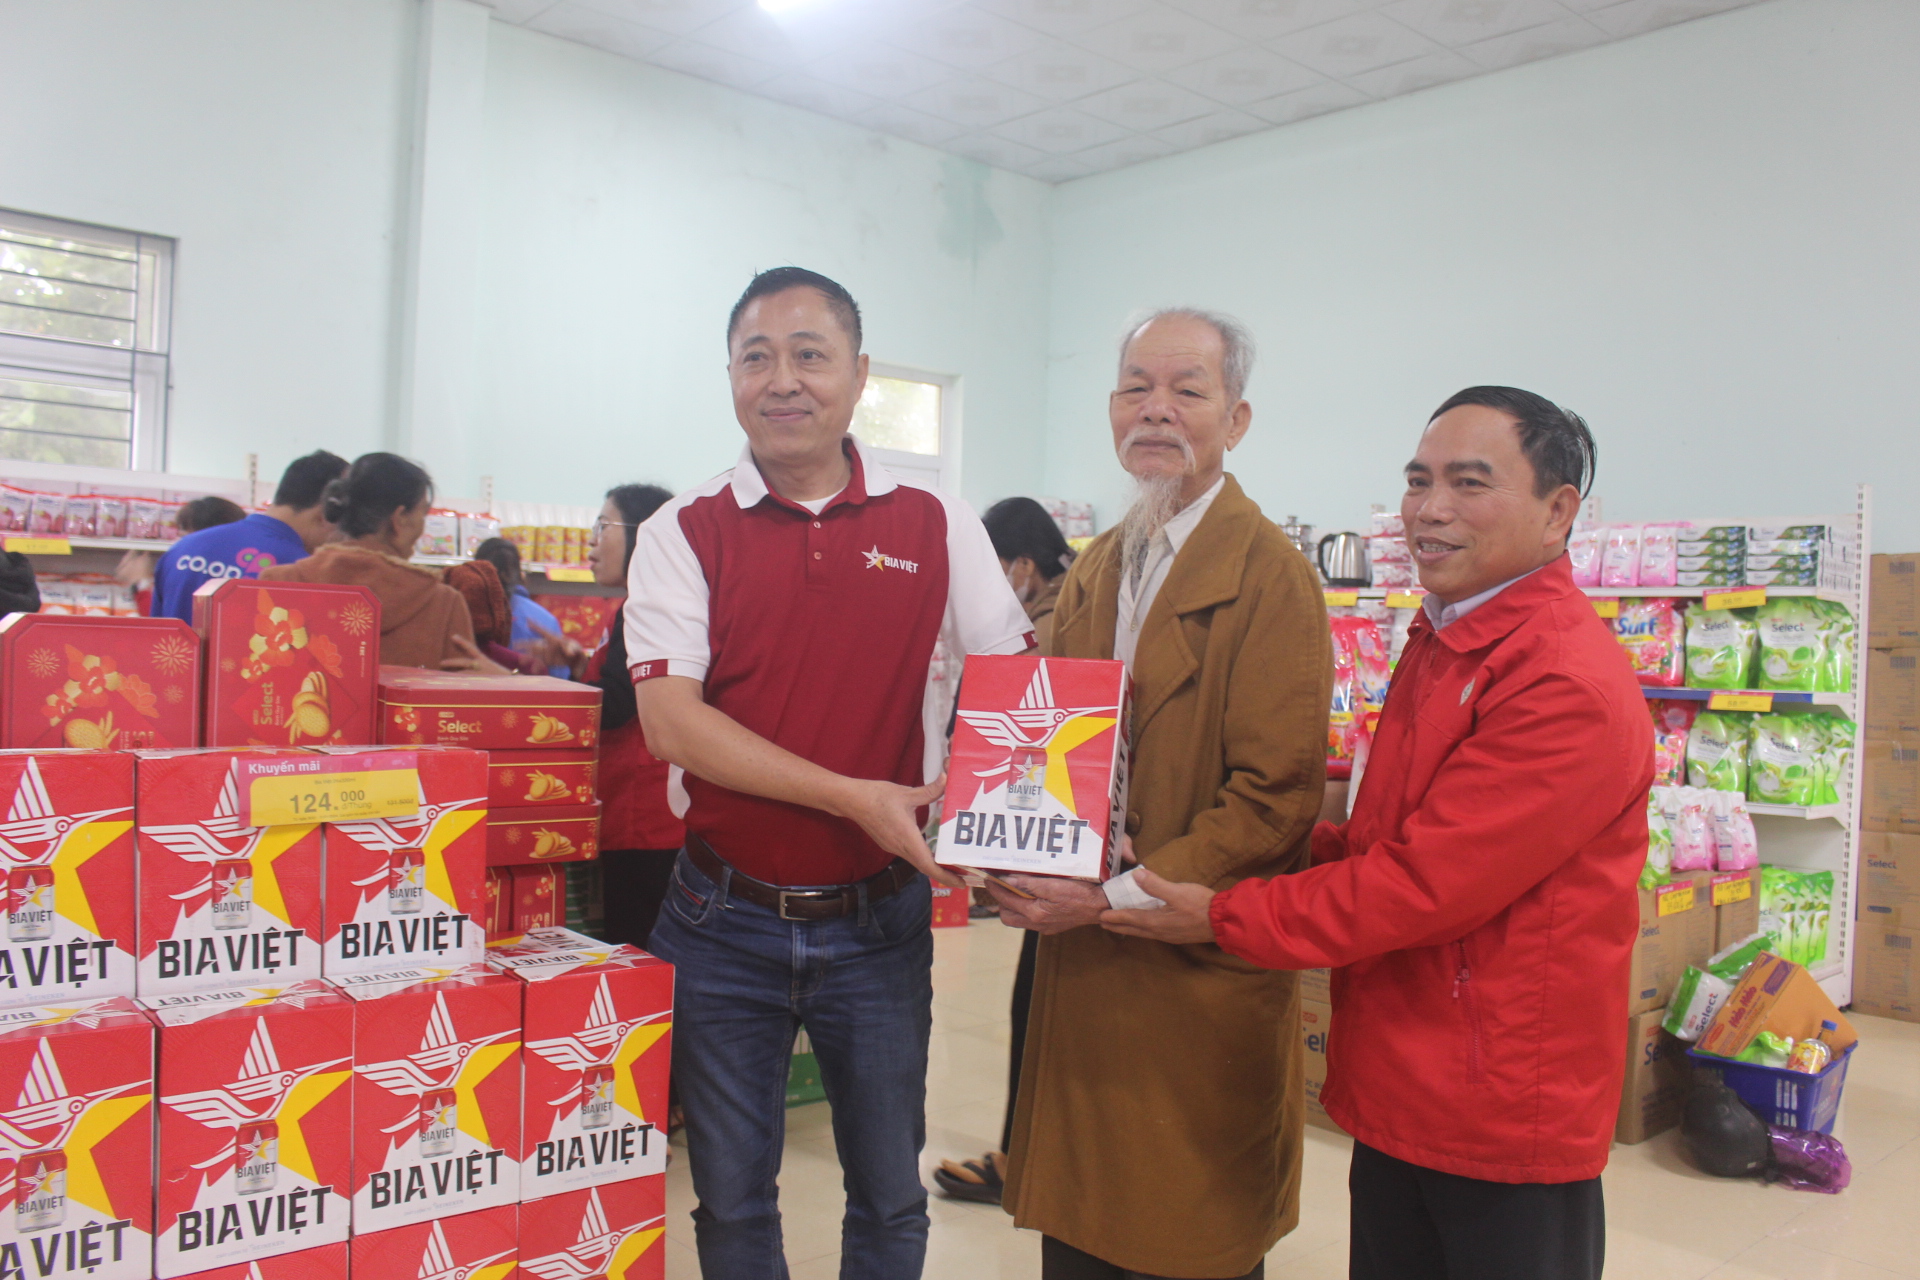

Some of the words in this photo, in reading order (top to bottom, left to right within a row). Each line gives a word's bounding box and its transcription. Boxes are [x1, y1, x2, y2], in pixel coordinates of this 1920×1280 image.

[1617, 616, 1658, 636] Surf
[1703, 618, 1729, 632] Select
[1771, 620, 1805, 632] Select
[261, 681, 274, 725] Select
[437, 719, 483, 733] Select
[1701, 734, 1729, 749] Select
[248, 761, 295, 775] Khuyến
[299, 761, 321, 772] mãi
[1867, 857, 1898, 869] Select
[1695, 993, 1718, 1033] Select
